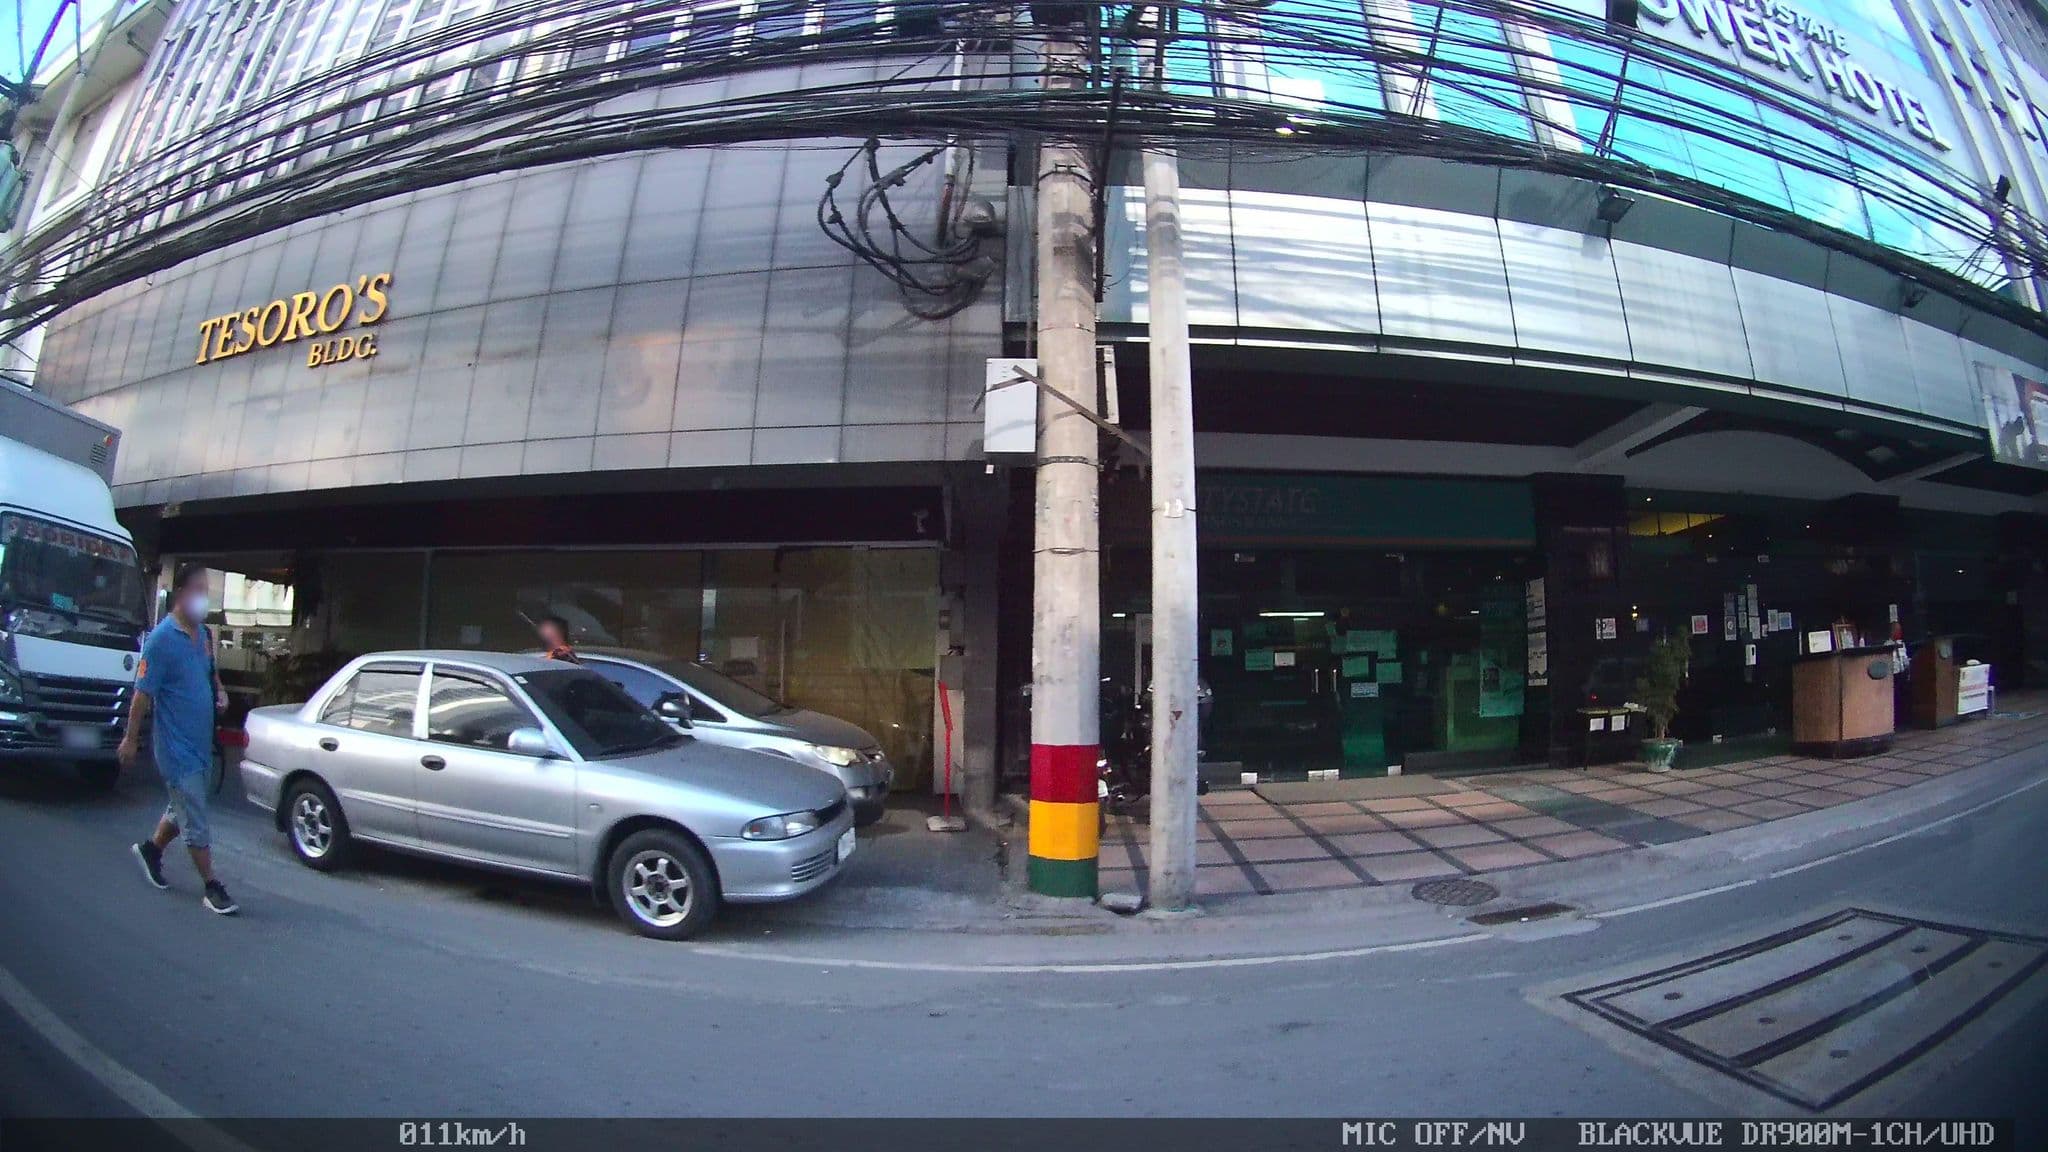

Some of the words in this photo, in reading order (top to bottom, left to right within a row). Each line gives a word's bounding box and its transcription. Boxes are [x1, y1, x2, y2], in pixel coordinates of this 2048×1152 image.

[1736, 0, 1848, 54] YSTATE
[1808, 41, 1952, 151] HOTEL
[195, 272, 391, 364] TESORO'S
[306, 332, 378, 368] BLDG.
